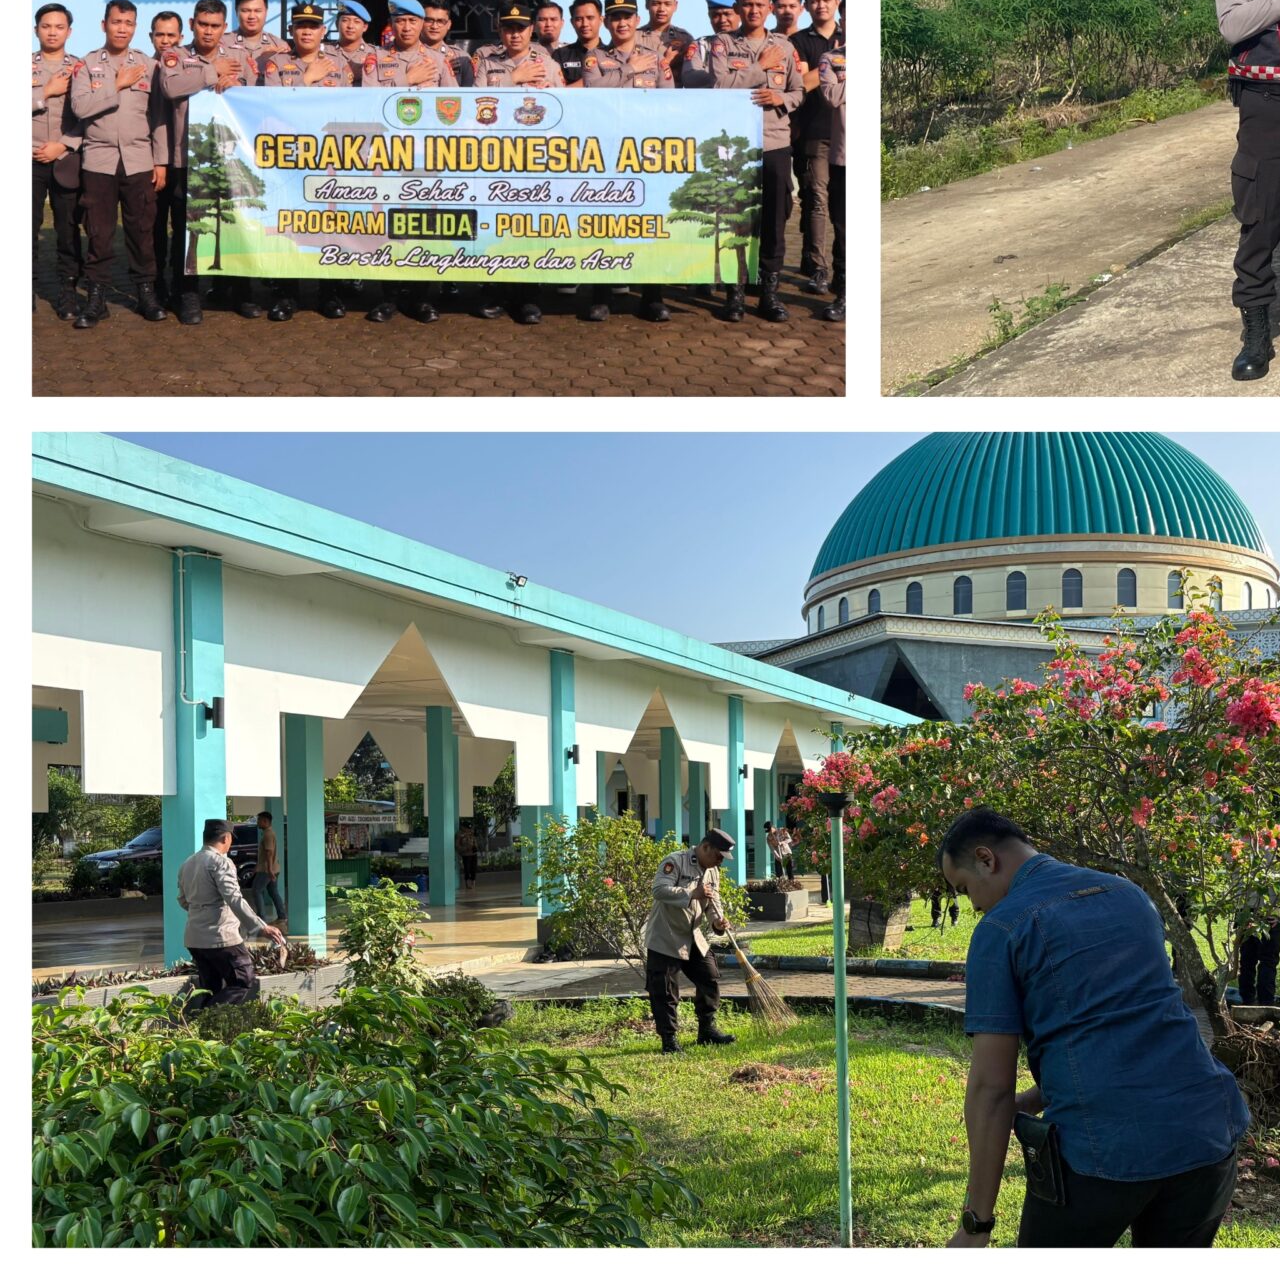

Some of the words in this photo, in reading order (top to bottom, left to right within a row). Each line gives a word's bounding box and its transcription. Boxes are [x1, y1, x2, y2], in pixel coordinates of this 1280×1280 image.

[254, 134, 415, 171] GERAKAN
[424, 136, 605, 173] INDONESIA
[616, 137, 697, 173] ASRI
[315, 178, 377, 200] Aman
[399, 180, 469, 201] Sehat
[488, 181, 552, 202] Resik
[571, 181, 636, 203] Indah
[278, 209, 386, 235] PROGRAM
[393, 213, 473, 236] BELIDA
[495, 213, 571, 238] POLDA
[577, 214, 671, 239] SUMSEL
[319, 245, 392, 266] Bersih
[395, 246, 529, 275] Lingkungan
[535, 248, 576, 269] dan
[580, 249, 634, 270] Asri
